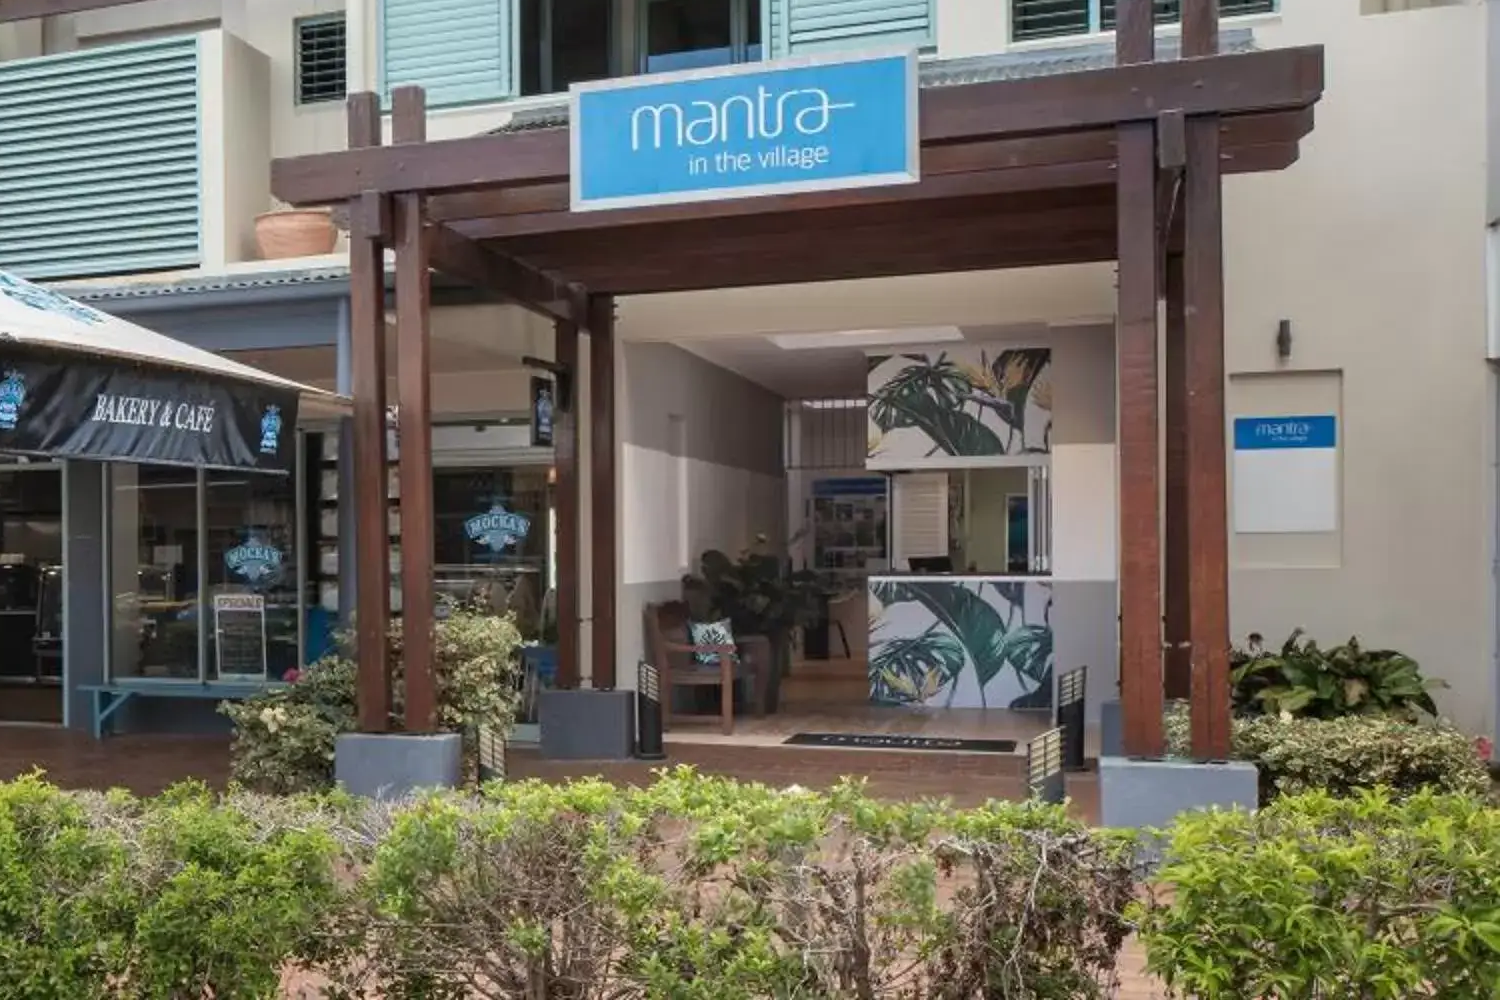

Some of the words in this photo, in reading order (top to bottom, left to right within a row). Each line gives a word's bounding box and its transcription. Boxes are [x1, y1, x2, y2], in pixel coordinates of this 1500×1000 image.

[631, 85, 856, 151] mantra
[689, 154, 708, 175] in
[715, 151, 750, 172] the
[759, 145, 829, 170] village
[92, 394, 161, 426] BAKERY
[160, 400, 173, 427] &
[175, 400, 216, 433] CAFÉ
[1255, 420, 1315, 437] mantra
